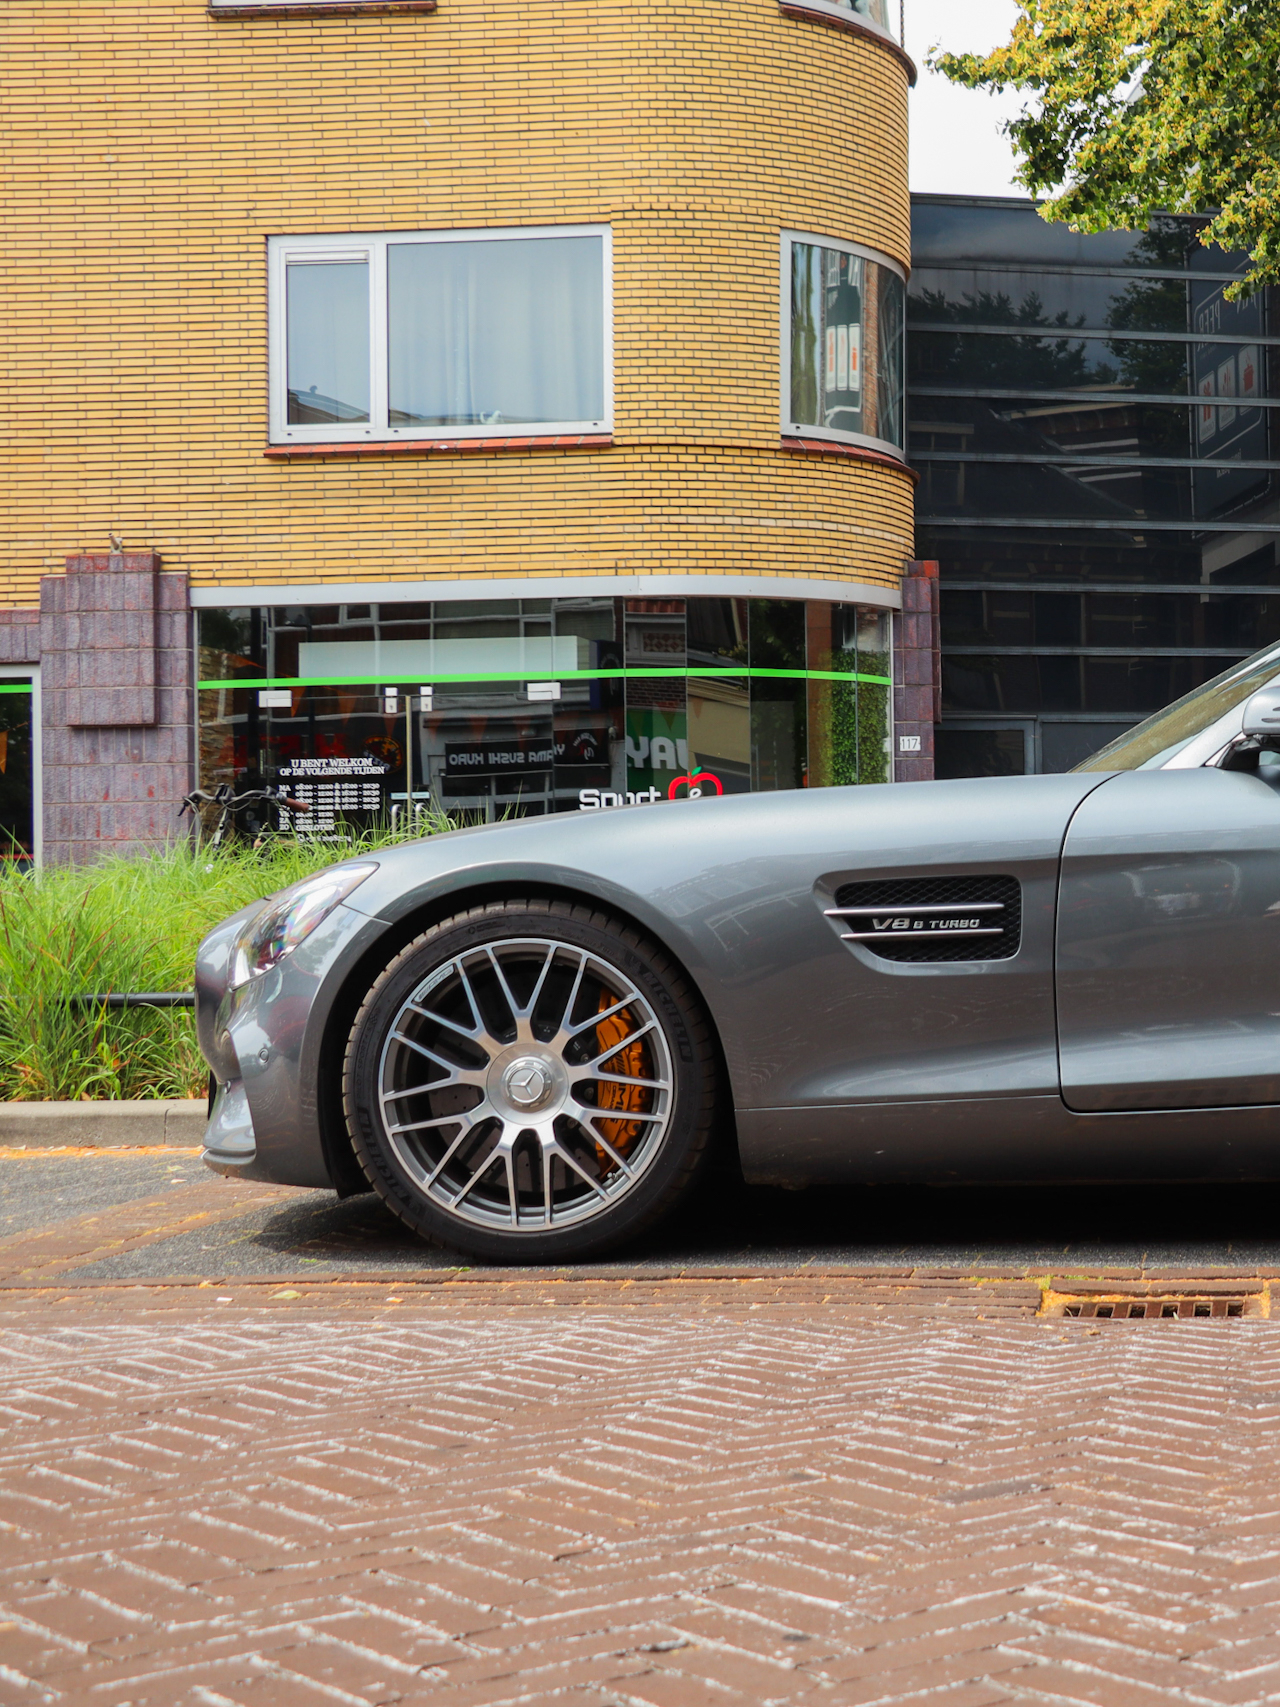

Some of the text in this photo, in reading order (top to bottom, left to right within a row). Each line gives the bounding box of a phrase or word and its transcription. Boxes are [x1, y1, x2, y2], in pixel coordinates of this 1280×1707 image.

[901, 738, 918, 750] 117
[290, 759, 299, 768] U
[299, 758, 328, 768] BENT
[328, 757, 373, 767] WELKOM
[280, 766, 385, 776] OP DE VOLGENDE TIJDEN
[872, 917, 910, 930] V8
